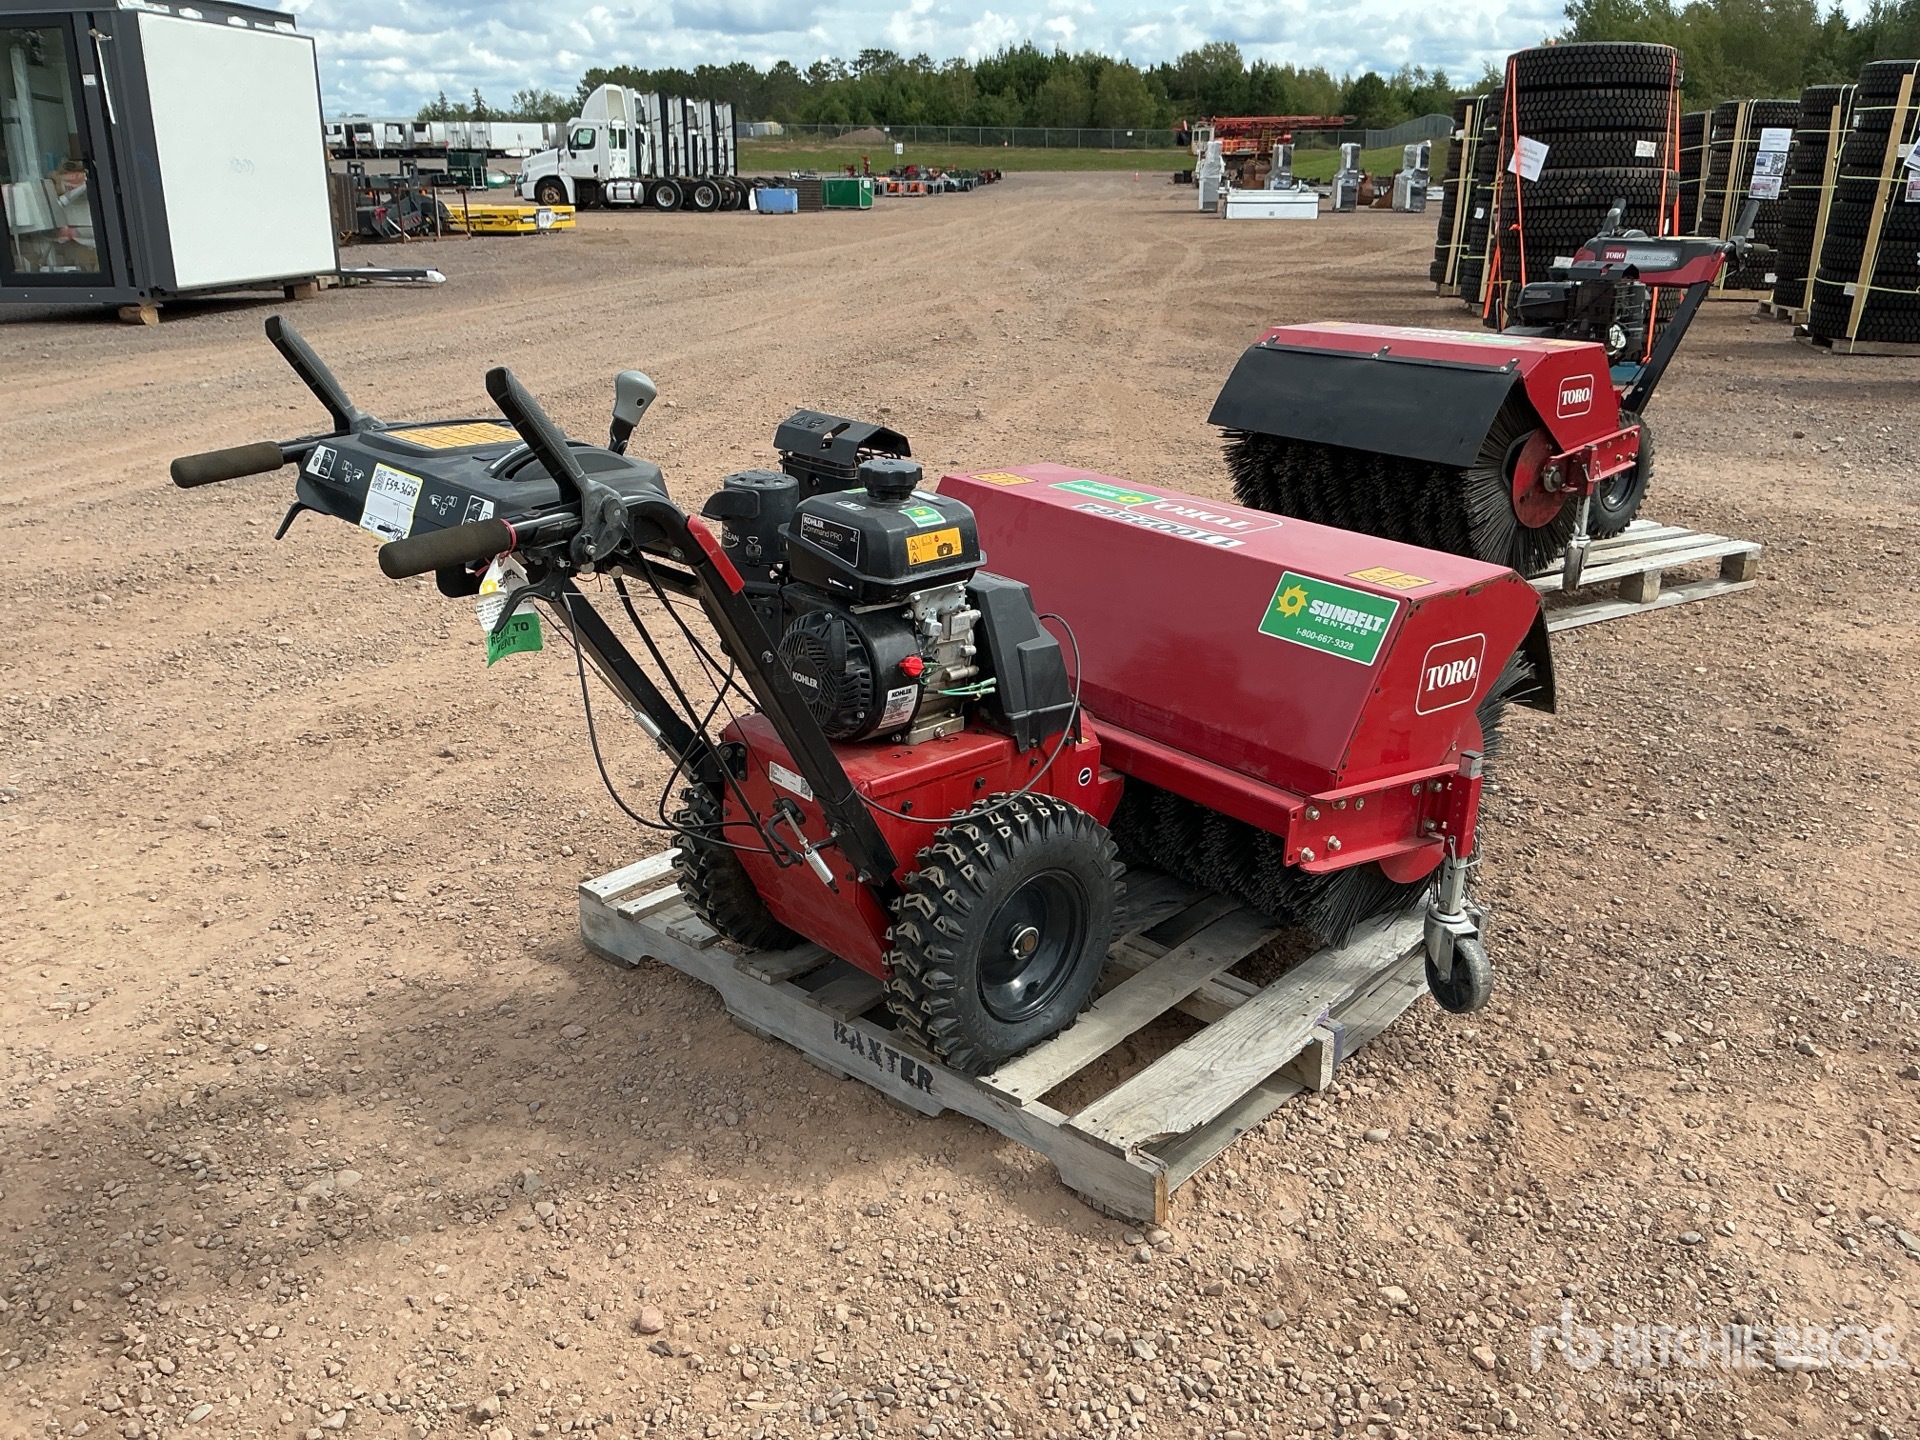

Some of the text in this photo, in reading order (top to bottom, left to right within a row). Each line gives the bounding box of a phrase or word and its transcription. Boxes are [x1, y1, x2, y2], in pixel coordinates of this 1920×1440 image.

[1605, 251, 1625, 260] TORO
[1561, 387, 1590, 406] TORO
[803, 516, 824, 529] KOHLER
[1153, 501, 1255, 530] TORO
[803, 523, 830, 538] Command
[830, 530, 843, 542] PRO
[1308, 599, 1386, 632] SUNBELT
[513, 621, 530, 632] TO
[1314, 616, 1368, 636] RENTALS
[1296, 627, 1355, 651] 1-800-667-9328
[792, 670, 819, 690] KOHLER
[1426, 656, 1476, 692] TORO
[833, 1019, 934, 1096] BAXTER
